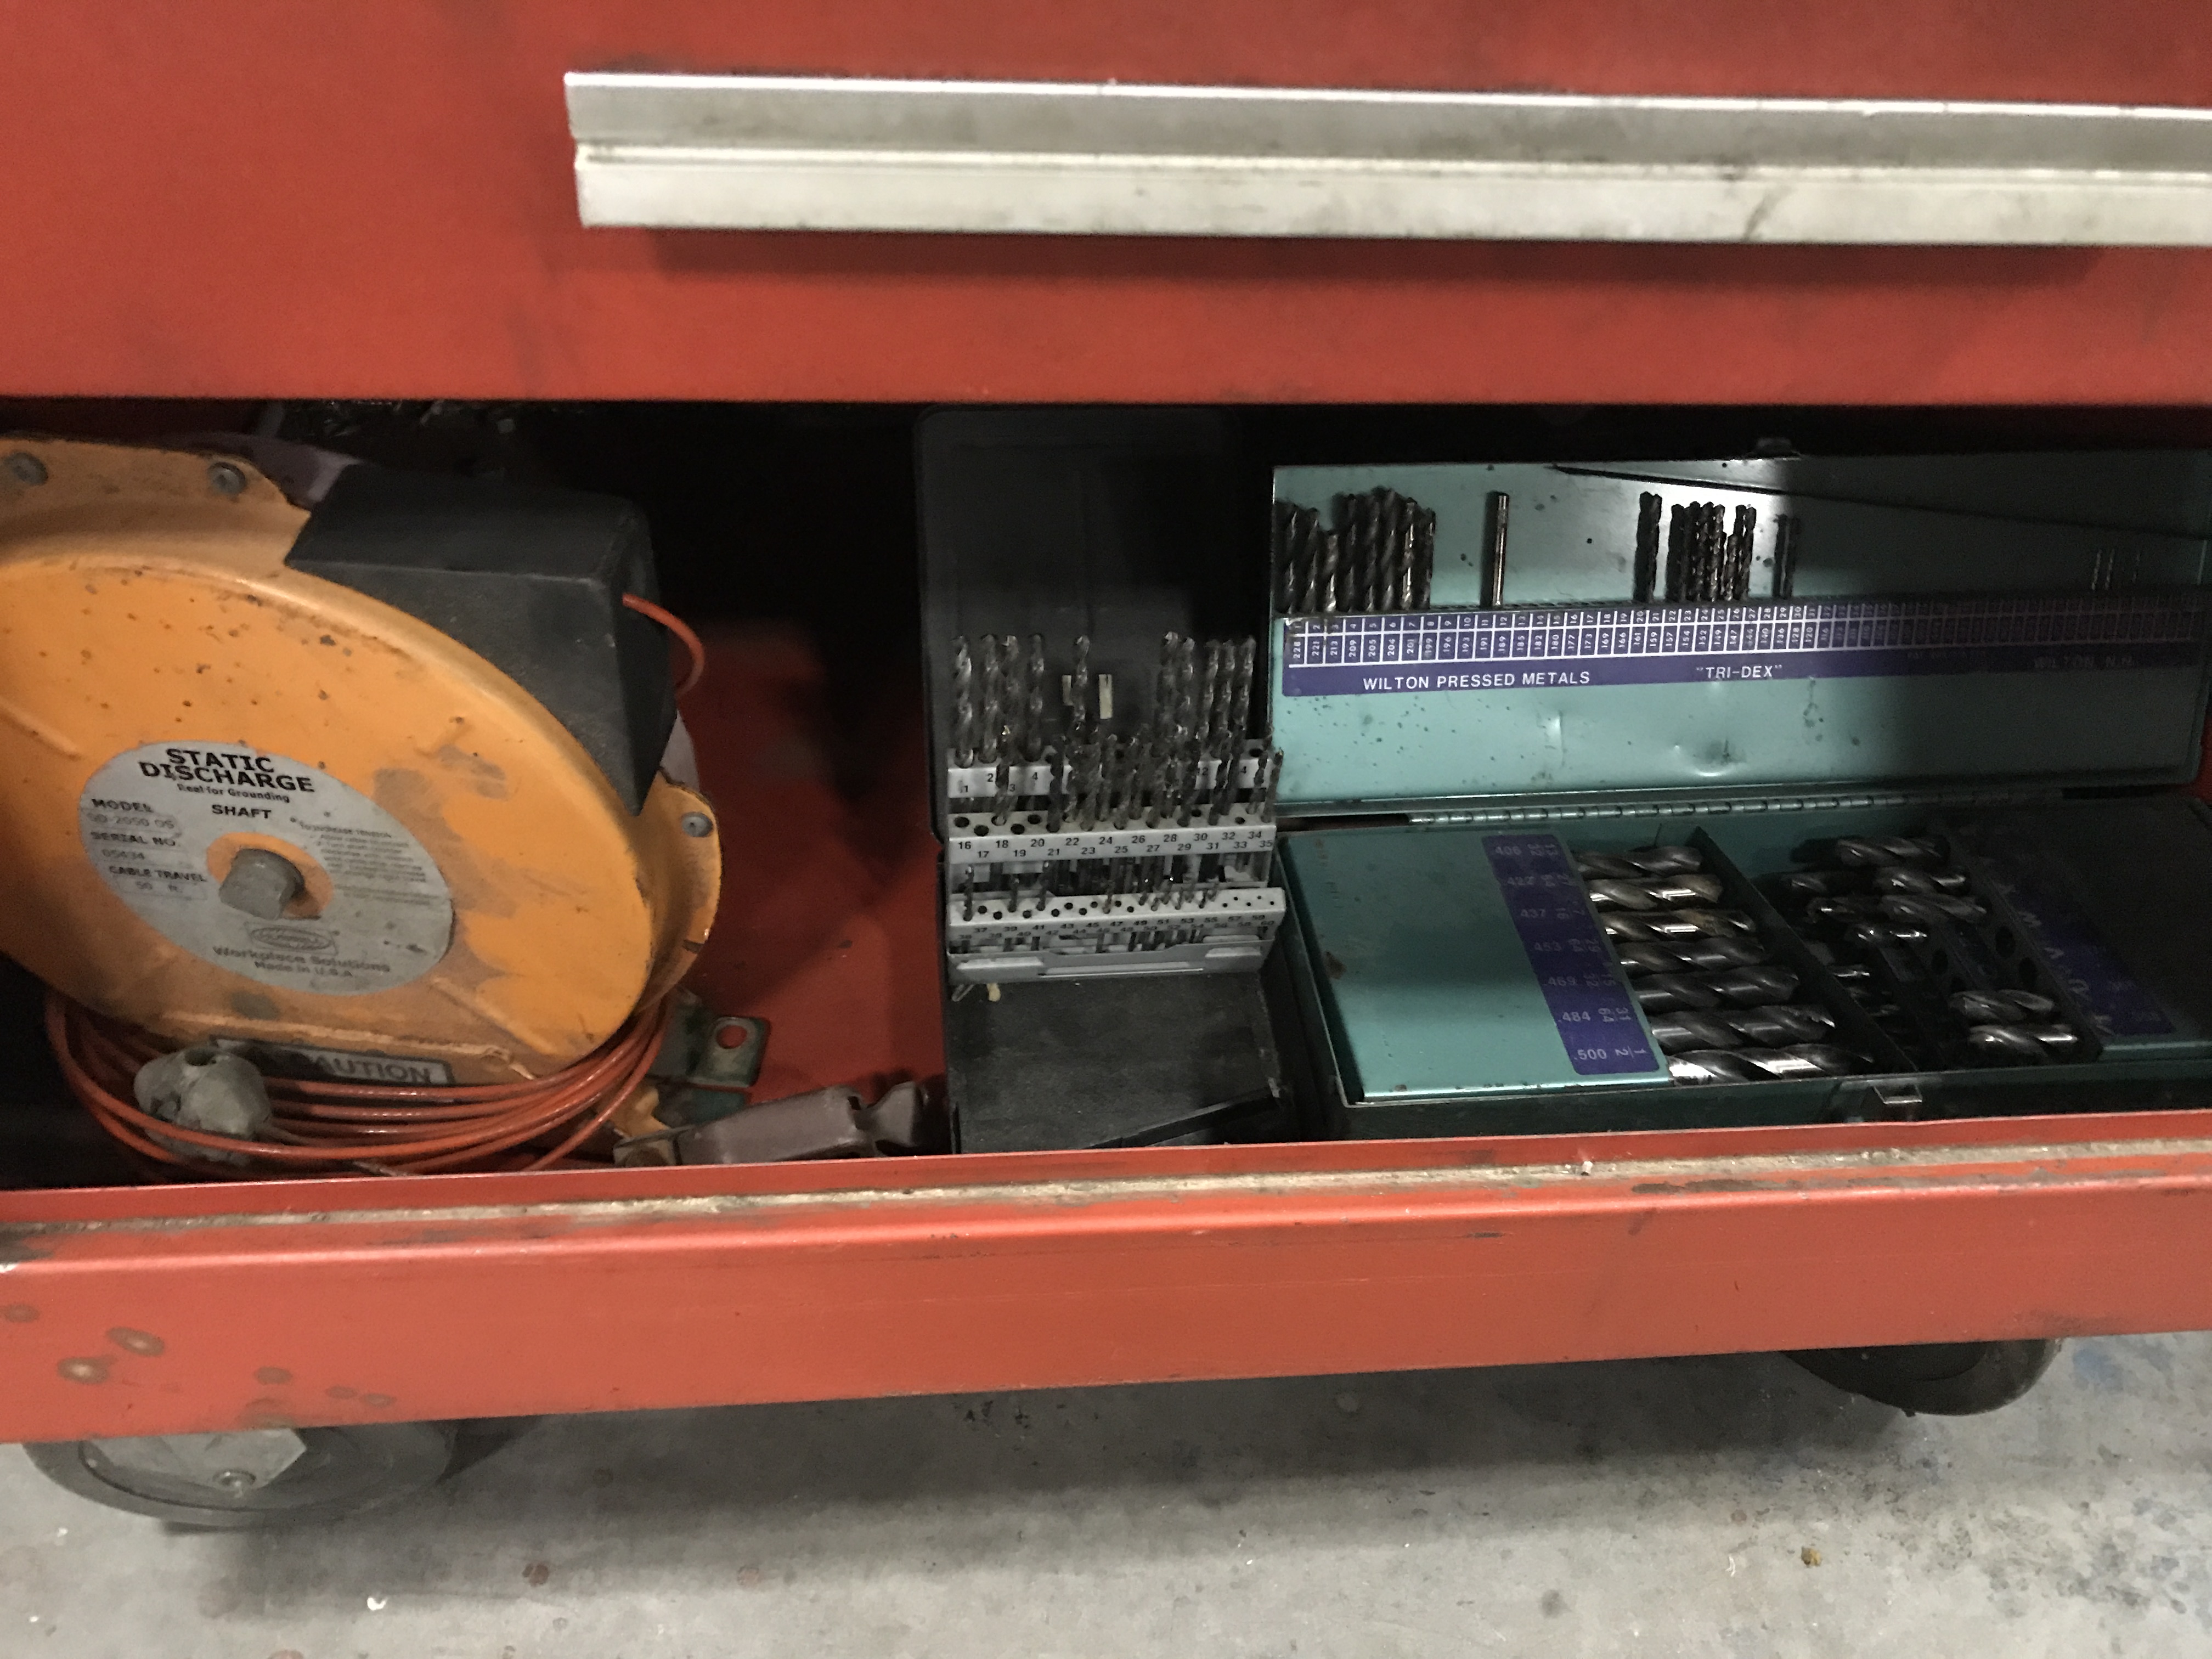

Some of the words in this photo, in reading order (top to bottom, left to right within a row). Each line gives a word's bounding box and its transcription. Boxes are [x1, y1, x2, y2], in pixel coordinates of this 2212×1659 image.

[1570, 614, 1577, 623] 16
[1587, 614, 1593, 623] 17
[1603, 614, 1611, 623] 18
[1620, 613, 1628, 622] 19
[1637, 611, 1644, 623] 20
[1652, 612, 1659, 622] 21
[1668, 610, 1676, 622] 22
[1684, 610, 1691, 621] 23
[1701, 609, 1708, 620] 24
[1717, 609, 1725, 620] 25
[1733, 608, 1740, 619] 26
[1748, 608, 1756, 619] 27
[1464, 617, 1471, 626] 10
[1500, 617, 1508, 625] 12
[1518, 616, 1526, 625] 13
[1536, 615, 1544, 624] 14
[1553, 615, 1560, 624] 15
[1551, 634, 1559, 649] 180
[1584, 634, 1593, 648] 173
[1699, 630, 1707, 644] 152
[1368, 639, 1376, 657] 205
[1696, 664, 1782, 679] "TRI-DEX"
[1363, 676, 1429, 690] WILTON
[1437, 673, 1515, 688] PRESSED
[1522, 672, 1590, 686] METALS
[166, 748, 275, 773] STATIC
[138, 761, 315, 793] DISCHARGE
[988, 773, 994, 782] 2
[1032, 771, 1039, 780] 4
[177, 783, 204, 793] Reel
[206, 785, 223, 795] for
[228, 788, 290, 803] Grounding
[1009, 783, 1015, 792] 3
[91, 798, 154, 812] MODEL
[211, 804, 272, 819] SHAFT
[91, 832, 149, 844] SERIAL
[958, 841, 972, 850] 16
[996, 839, 1009, 849] 18
[1030, 838, 1045, 847] 20
[1065, 837, 1079, 846] 22
[1099, 836, 1113, 845] 24
[1131, 835, 1146, 844] 26
[1163, 833, 1177, 843] 28
[1193, 833, 1208, 841] 30
[1221, 832, 1236, 840] 32
[1248, 831, 1262, 839] 34
[1047, 848, 1059, 856] 21
[1081, 847, 1096, 855] 23
[1114, 845, 1128, 854] 25
[1260, 839, 1273, 848] 35
[109, 866, 152, 877] CABLE
[154, 869, 208, 882] TRAVEL
[212, 945, 306, 964] Workplace
[309, 955, 391, 972] Solutions
[254, 961, 294, 972] Made
[314, 1054, 431, 1084] AUTION
